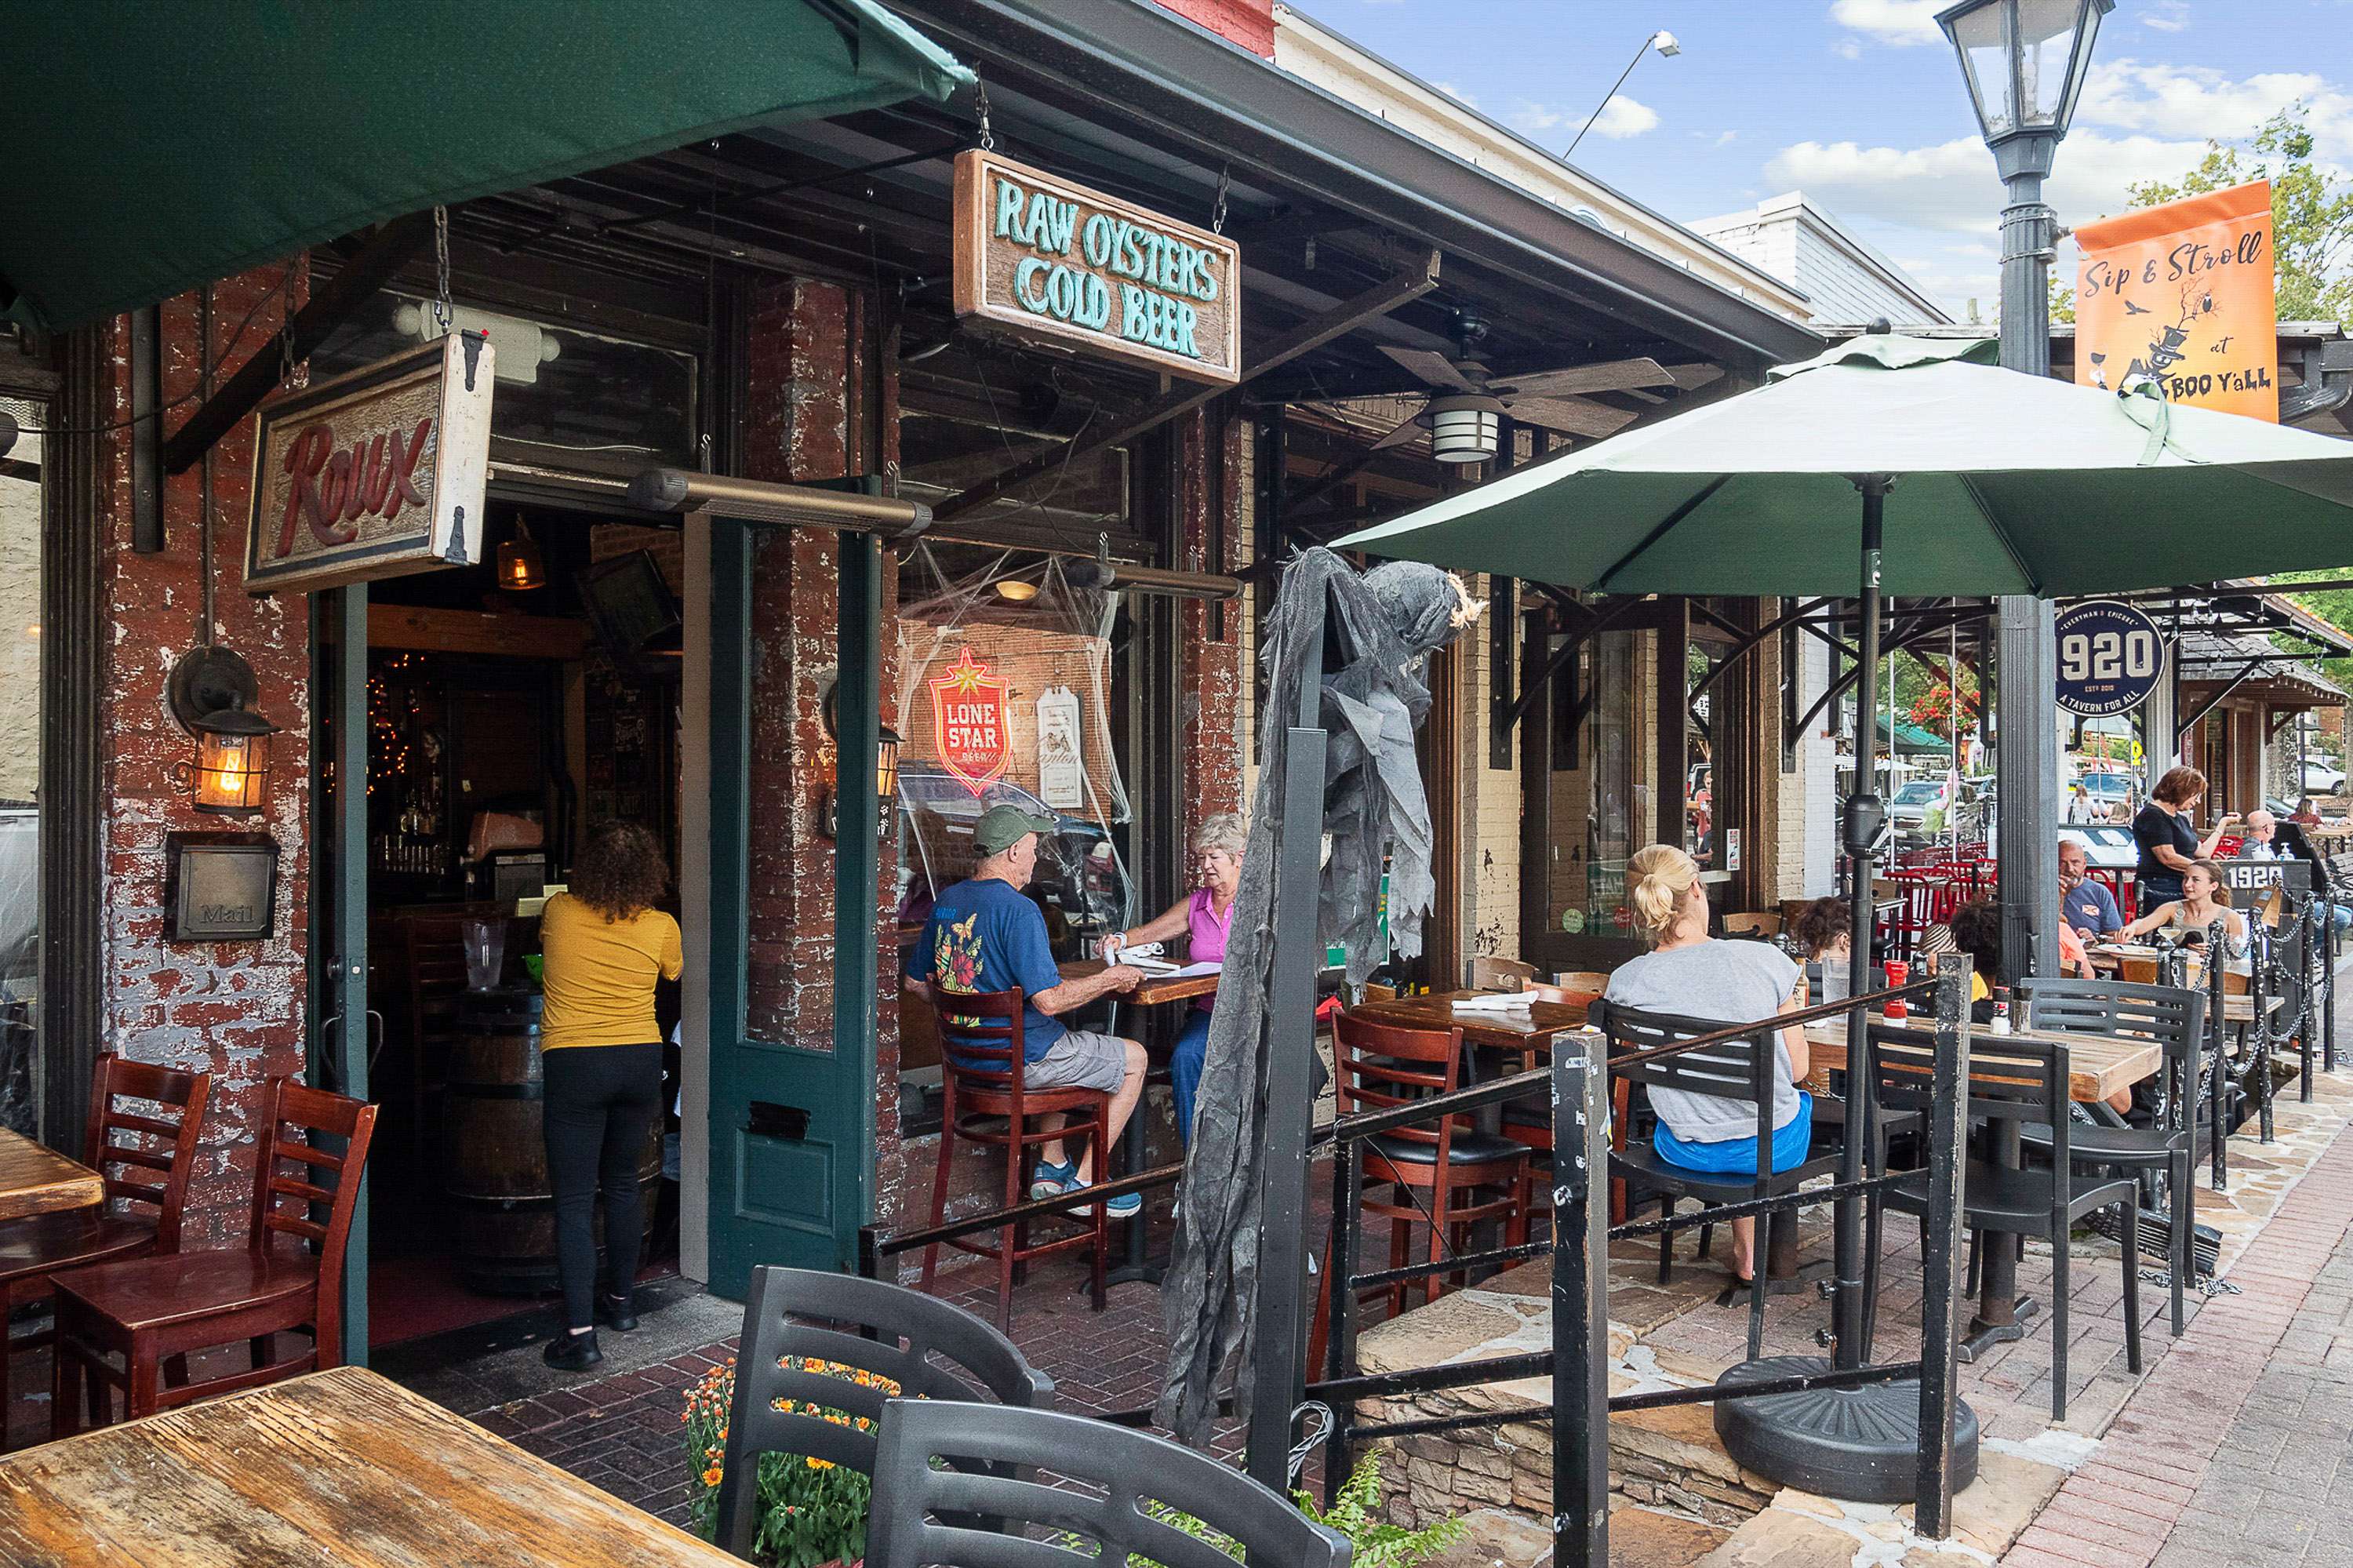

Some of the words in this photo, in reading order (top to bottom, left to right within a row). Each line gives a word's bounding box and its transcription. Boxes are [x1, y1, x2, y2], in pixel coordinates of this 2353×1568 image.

[995, 178, 1079, 257] RAW
[1082, 213, 1218, 302] OYSTERS
[2084, 261, 2129, 298] Sip
[2142, 259, 2157, 284] &
[2168, 231, 2263, 282] Stroll
[1014, 256, 1111, 331] COLD
[1118, 282, 1202, 358] BEER
[2210, 337, 2234, 354] at
[2170, 374, 2212, 401] BOO
[276, 418, 432, 558] Roux
[2056, 630, 2153, 681] 920
[947, 703, 995, 725] LONE
[2059, 694, 2068, 704] A
[2068, 697, 2102, 712] TAVERN
[2104, 699, 2122, 711] FOR
[2122, 690, 2140, 704] ALL
[948, 727, 998, 748] STAR
[199, 904, 255, 924] Mail
